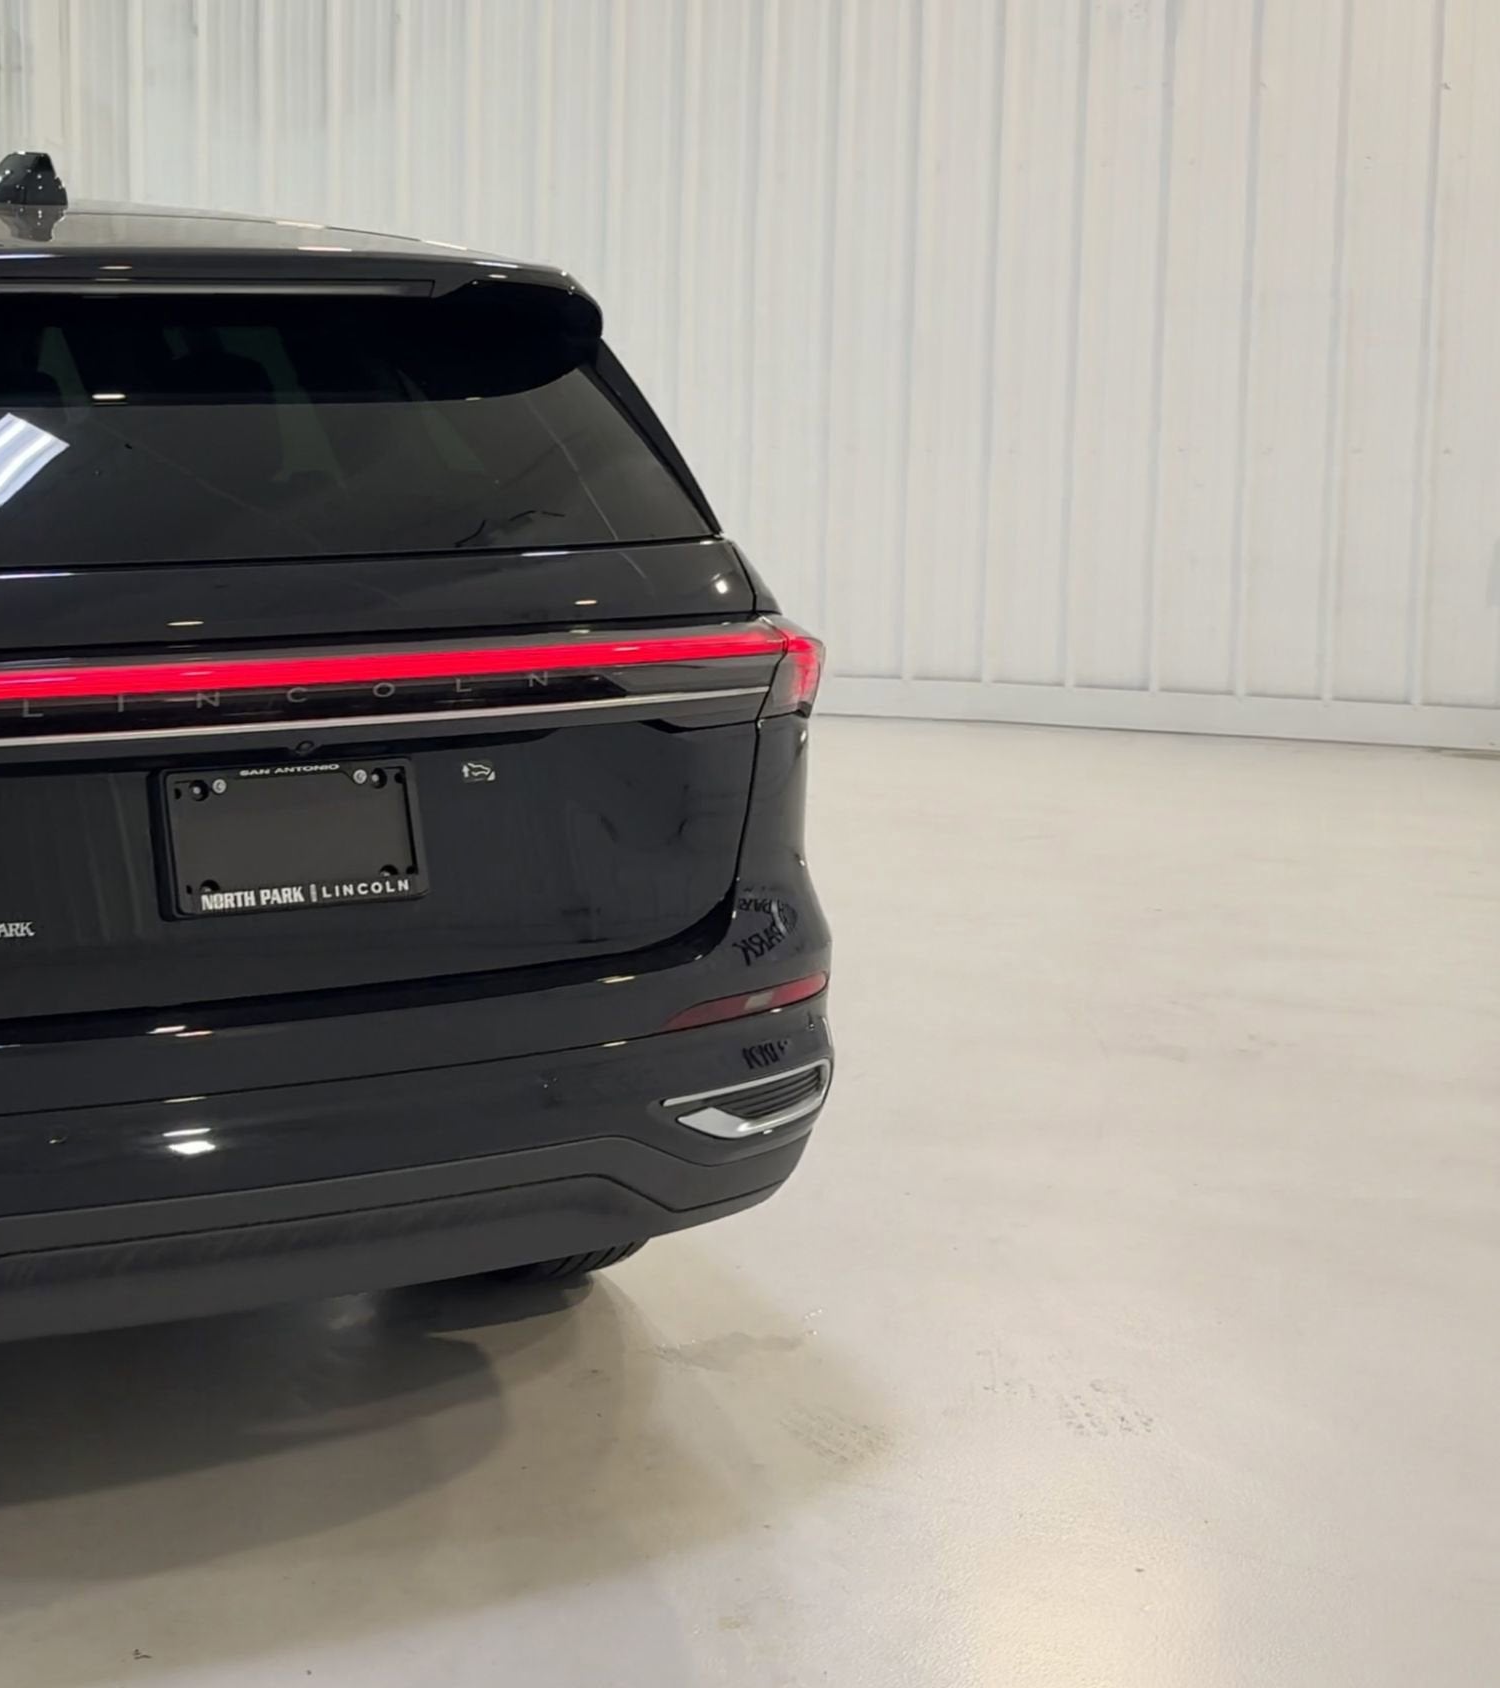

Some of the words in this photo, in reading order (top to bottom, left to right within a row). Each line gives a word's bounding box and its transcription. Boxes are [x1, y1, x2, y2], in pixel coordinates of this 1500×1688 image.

[21, 671, 550, 718] LINCOLN
[239, 767, 271, 777] SAN
[274, 763, 340, 774] ANTONIO
[200, 889, 256, 912] NORTH
[260, 886, 305, 906] PARK
[322, 879, 410, 898] LINCOLN
